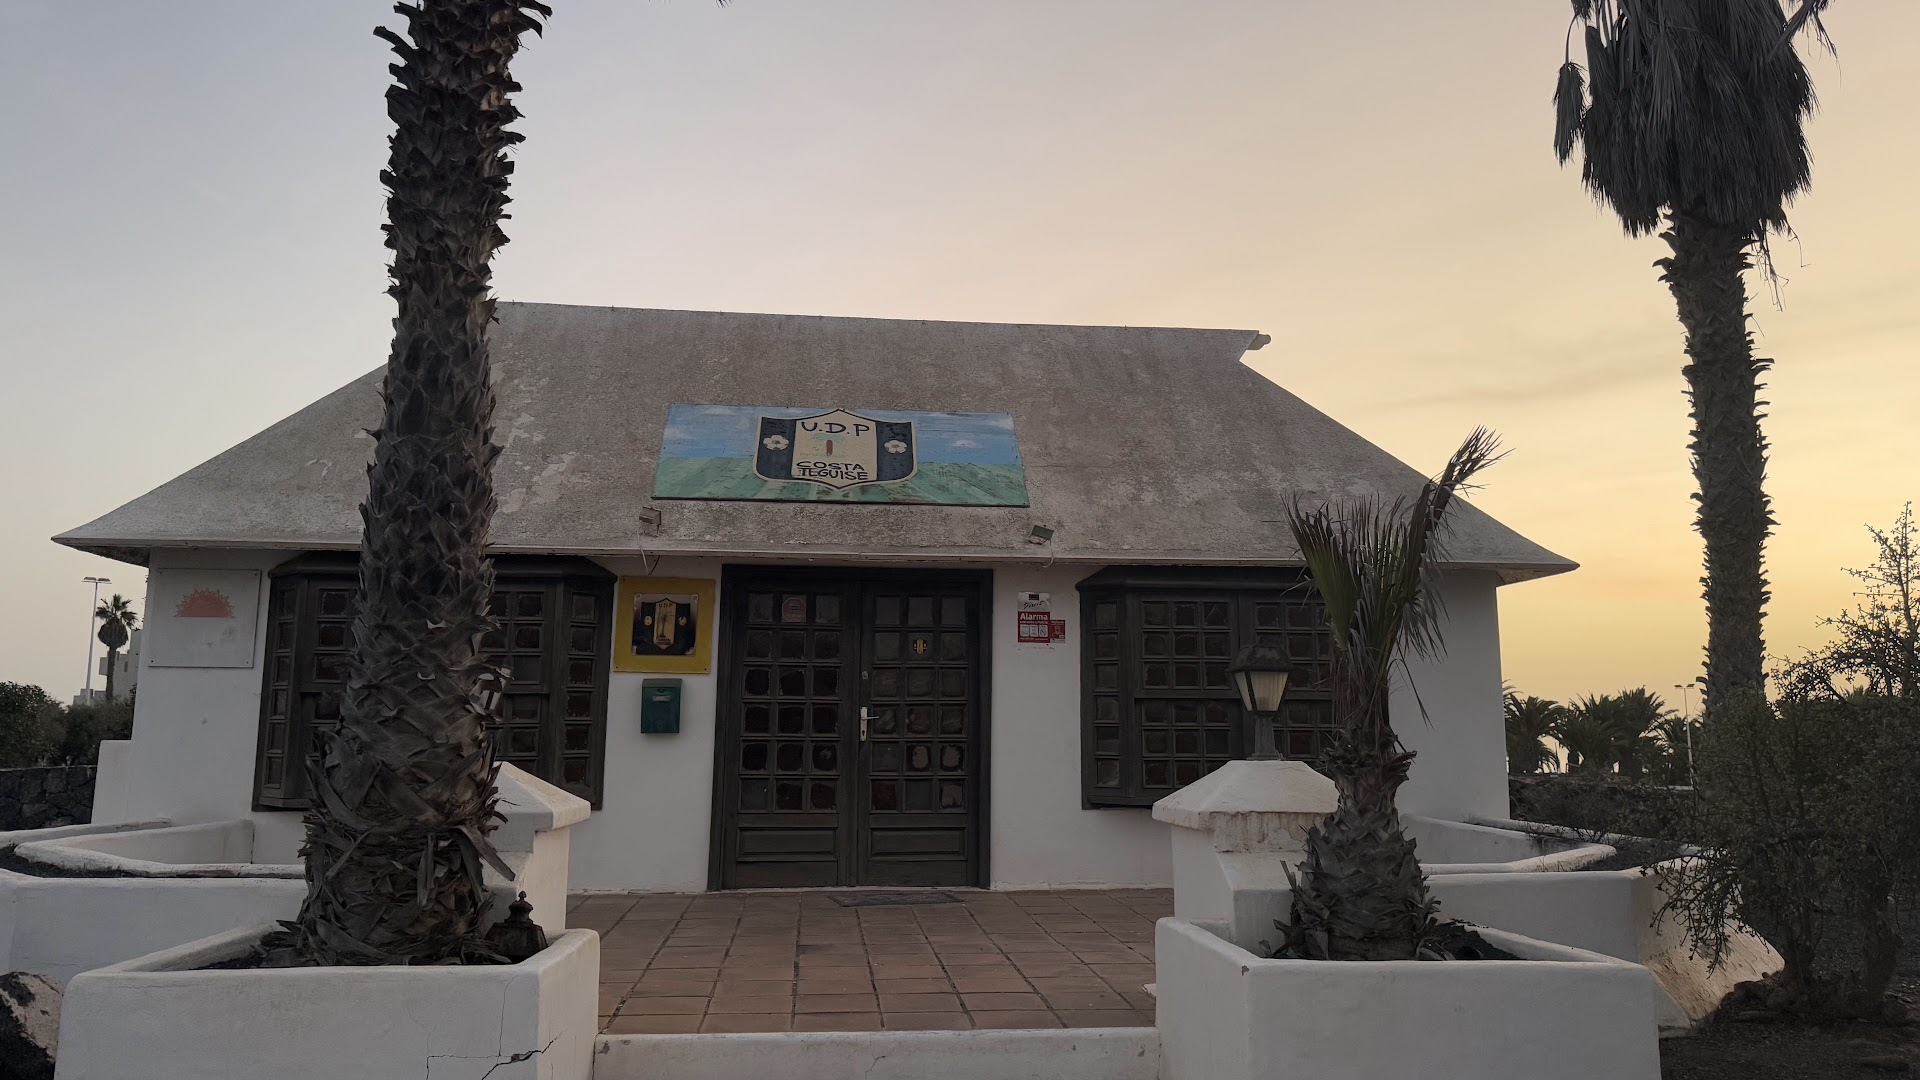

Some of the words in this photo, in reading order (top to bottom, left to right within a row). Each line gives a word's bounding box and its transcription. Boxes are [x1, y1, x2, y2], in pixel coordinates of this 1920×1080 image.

[796, 460, 865, 471] COSTA
[799, 467, 868, 480] TEGUISE
[1020, 612, 1048, 620] Alarma
